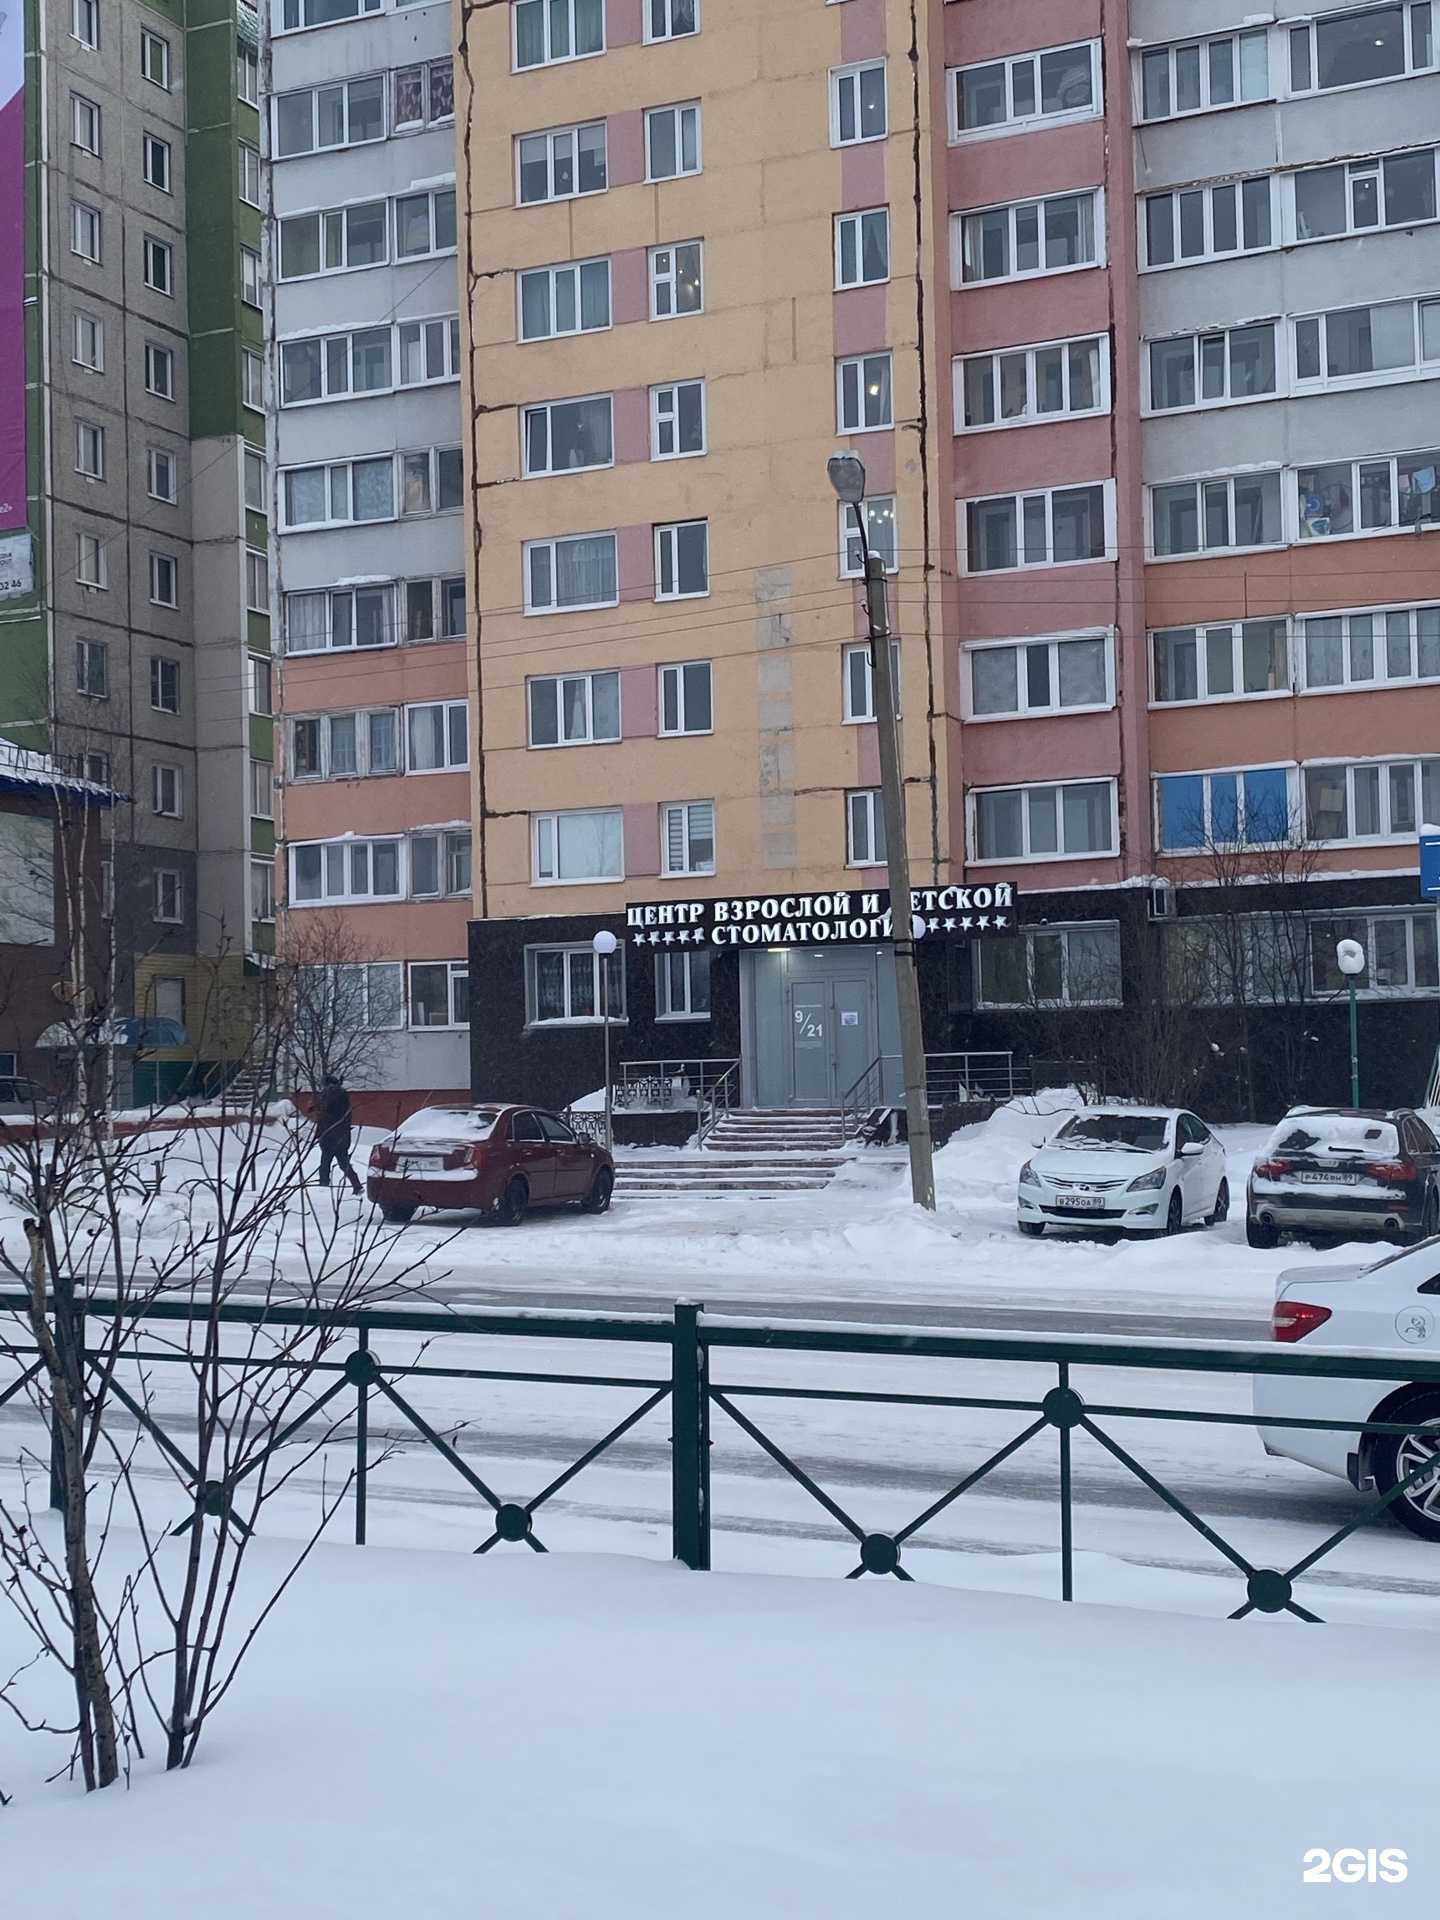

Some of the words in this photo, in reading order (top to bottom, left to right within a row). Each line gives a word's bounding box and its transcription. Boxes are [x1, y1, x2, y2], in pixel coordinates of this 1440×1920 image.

[627, 903, 704, 929] ЦЕНТР
[714, 892, 851, 922] ВЗРОСЛОЙ
[861, 894, 879, 914] И
[910, 883, 1013, 912] ЕТСКОЙ
[711, 916, 894, 945] СТОМАТОЛОГИ
